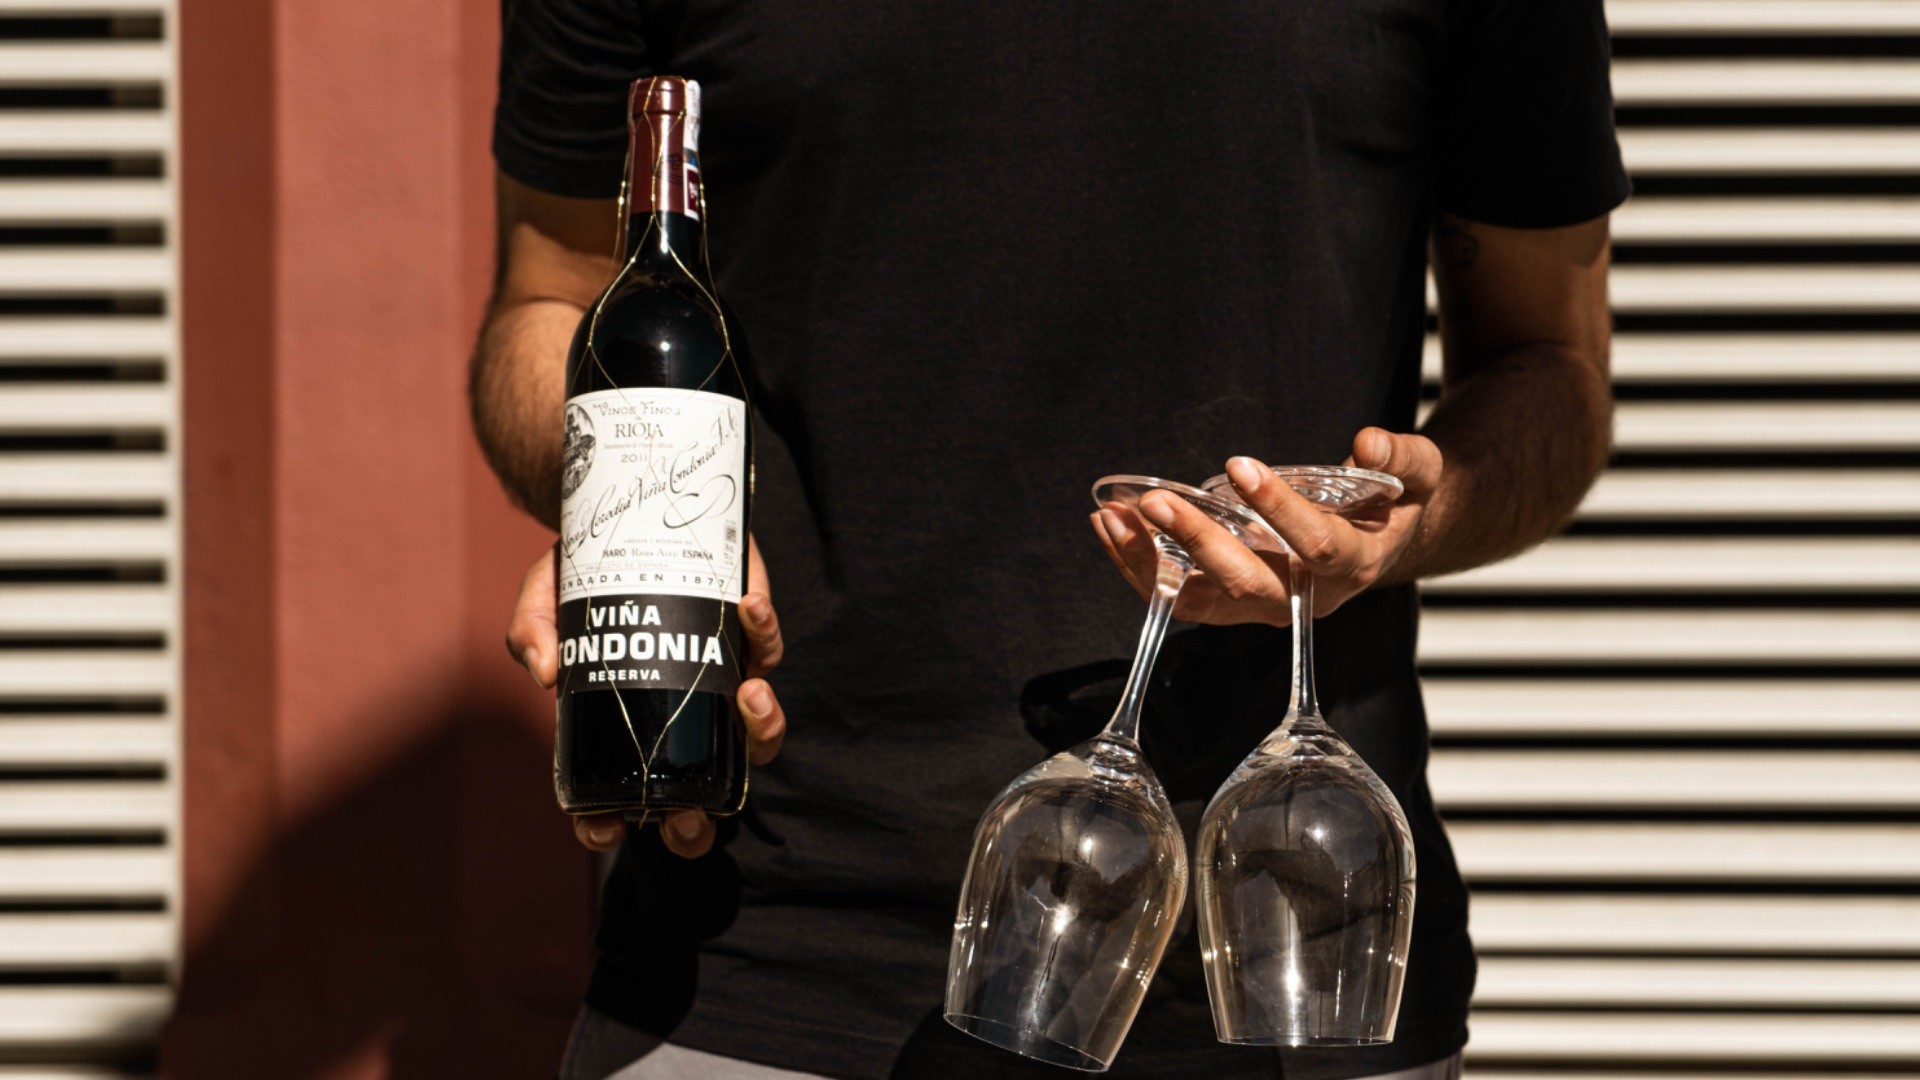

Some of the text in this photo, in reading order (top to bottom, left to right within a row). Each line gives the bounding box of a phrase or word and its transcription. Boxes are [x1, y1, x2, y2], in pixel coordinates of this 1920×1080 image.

[615, 423, 664, 439] RIOJA
[621, 453, 648, 463] 2011
[602, 548, 626, 558] HARO
[682, 549, 714, 561] ESPAÑA
[640, 574, 663, 582] EN
[682, 576, 725, 587] 1877
[590, 600, 662, 627] VIÑA
[588, 669, 661, 682] RESERVA
